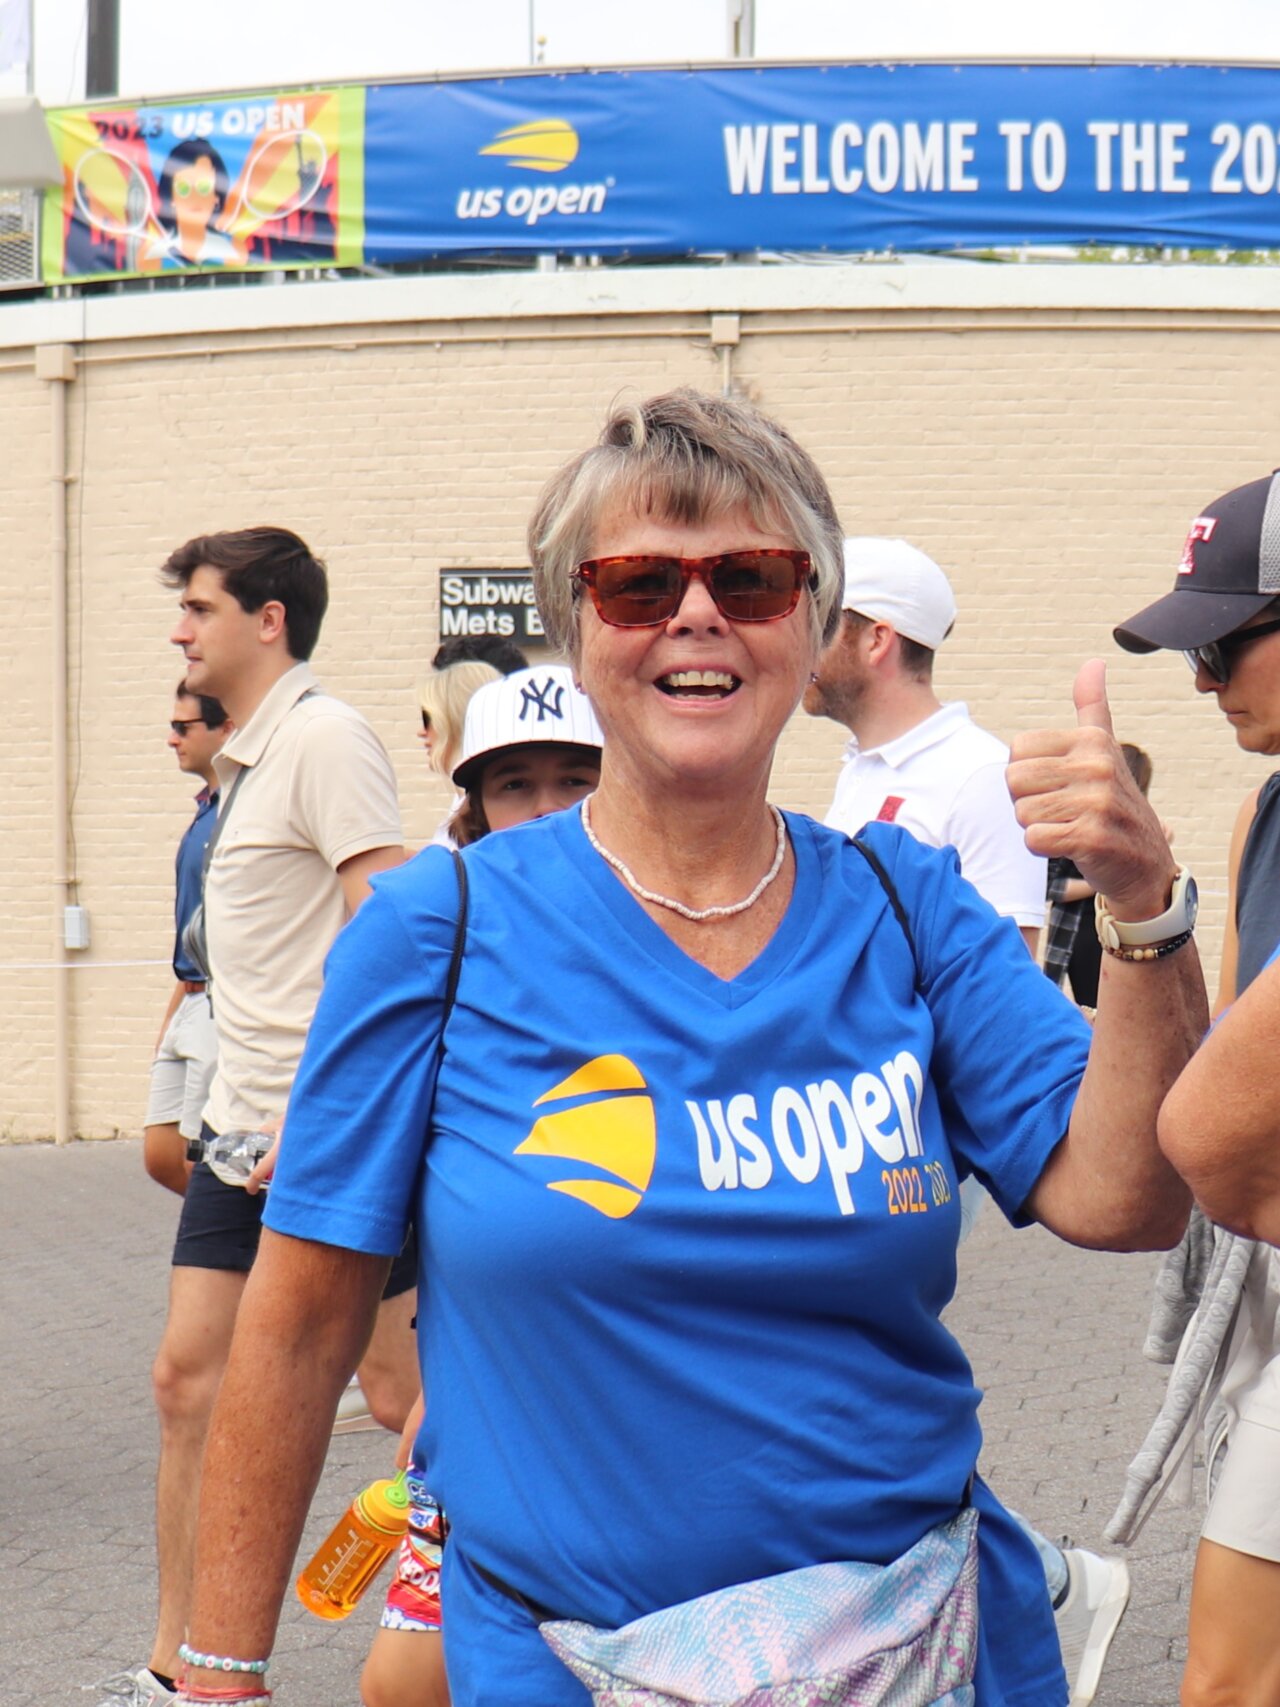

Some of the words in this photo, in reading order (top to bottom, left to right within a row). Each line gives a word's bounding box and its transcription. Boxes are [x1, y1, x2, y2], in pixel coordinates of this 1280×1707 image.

[95, 115, 164, 141] 2023
[171, 110, 214, 138] US
[221, 102, 305, 134] OPEN
[722, 121, 980, 195] WELCOME
[997, 121, 1068, 193] TO
[1086, 121, 1191, 193] THE
[456, 187, 504, 219] us
[505, 182, 607, 226] open
[442, 577, 536, 606] Subwa
[442, 607, 515, 636] Mets
[519, 677, 565, 722] NY
[685, 1094, 773, 1192] us
[770, 1050, 925, 1217] open
[881, 1166, 928, 1216] 2022
